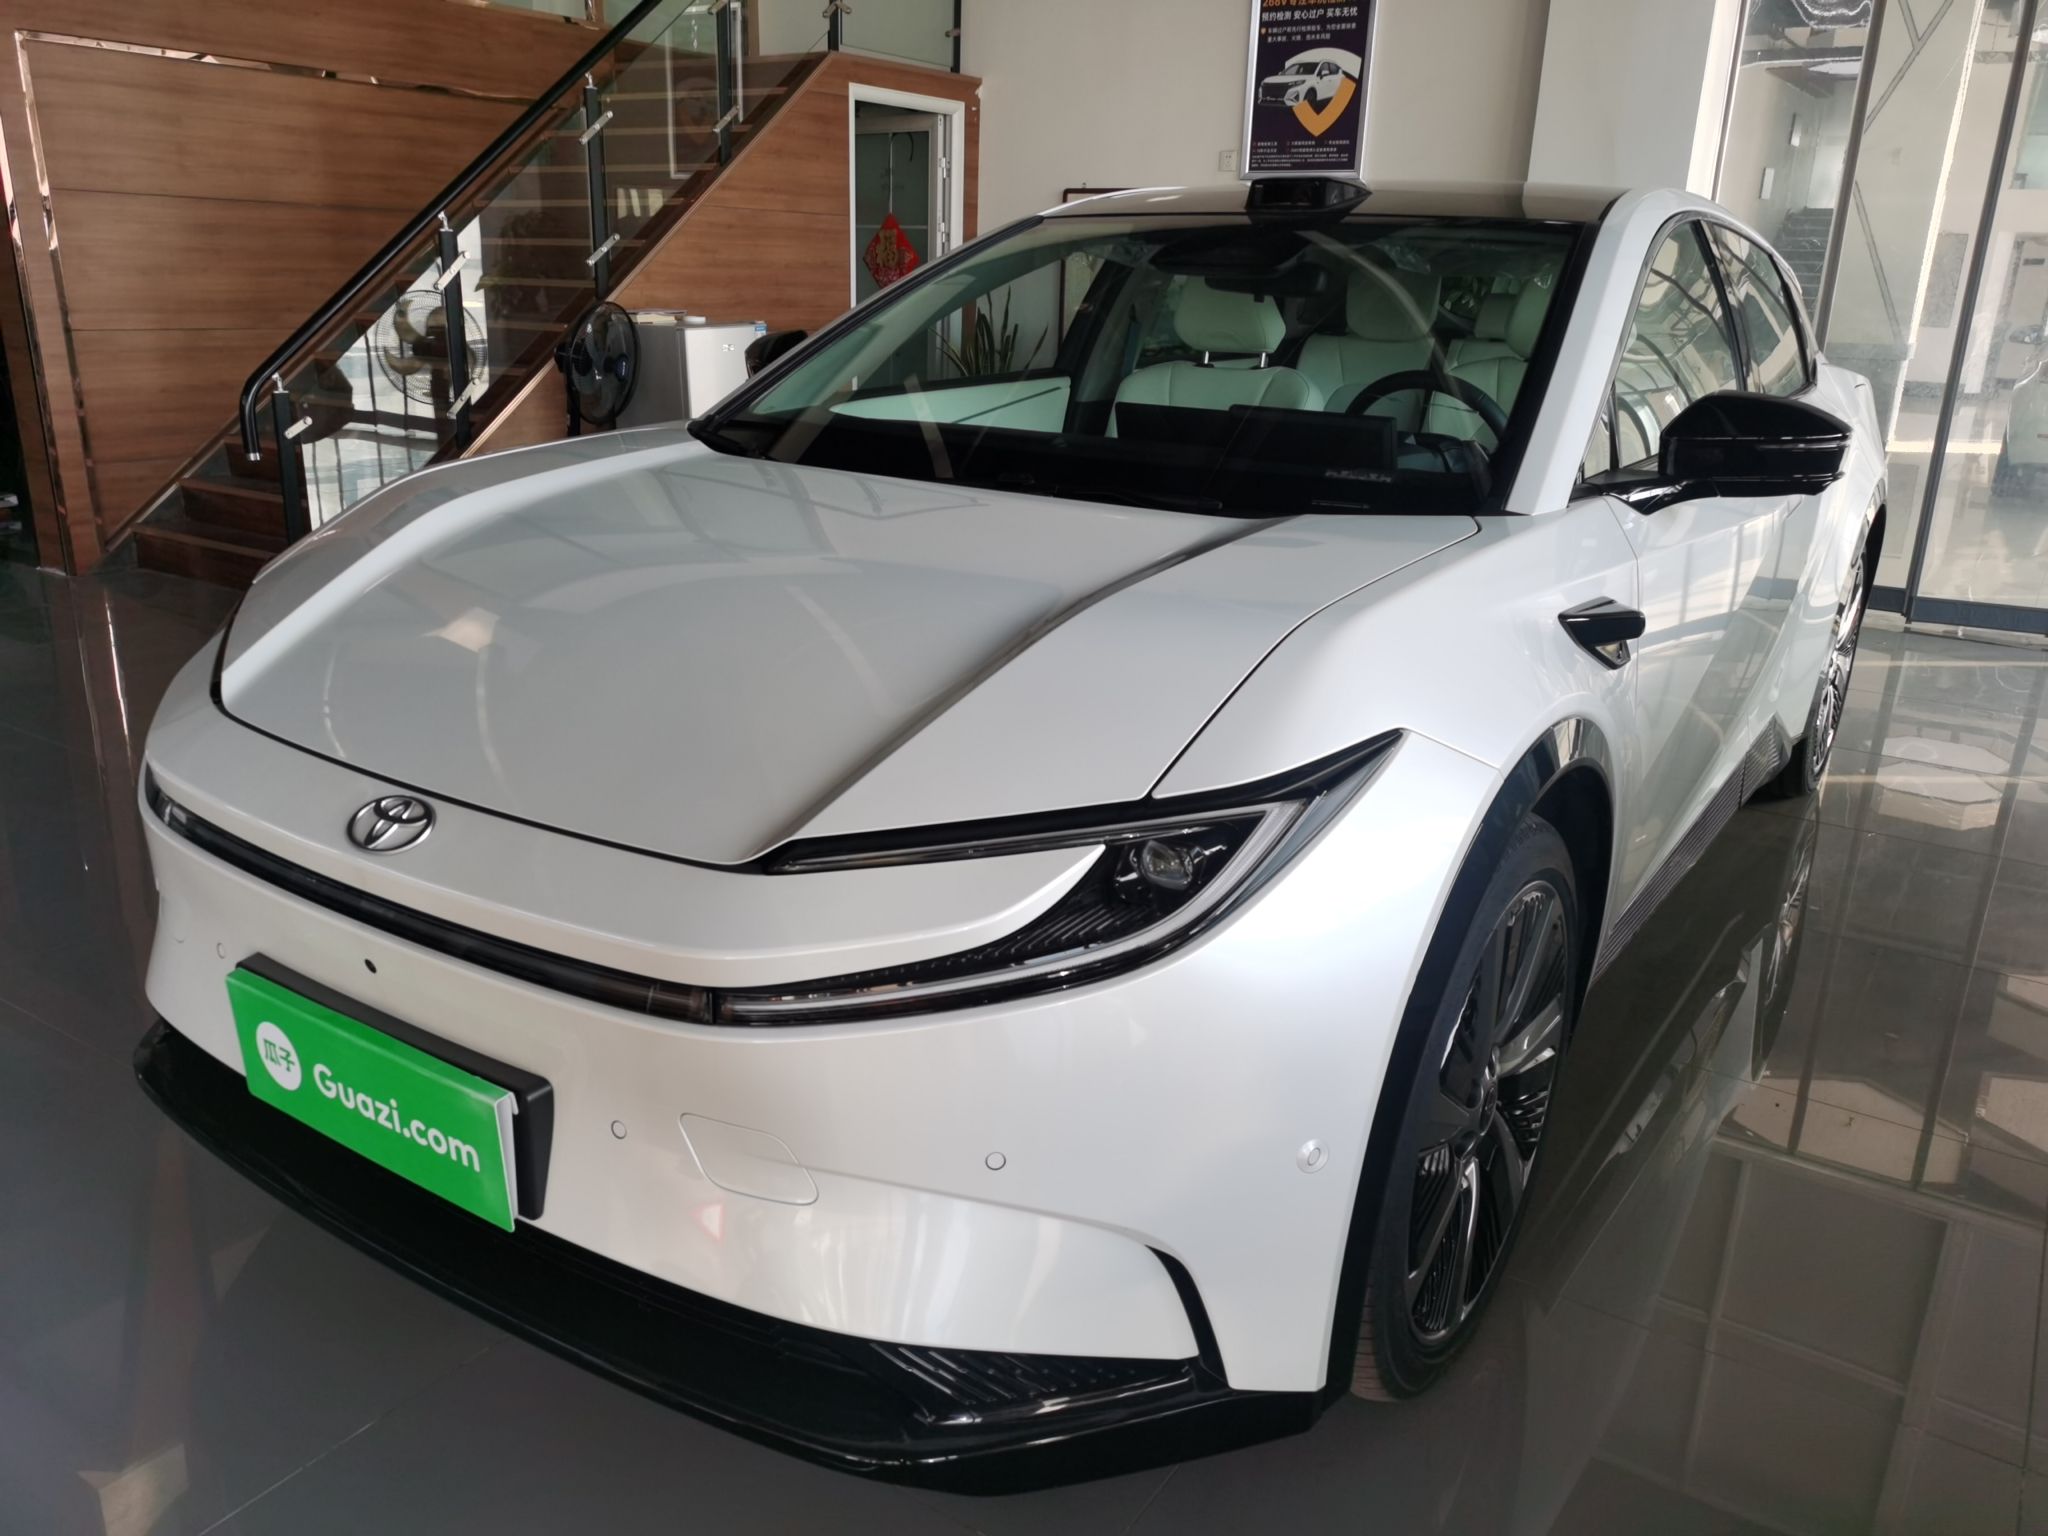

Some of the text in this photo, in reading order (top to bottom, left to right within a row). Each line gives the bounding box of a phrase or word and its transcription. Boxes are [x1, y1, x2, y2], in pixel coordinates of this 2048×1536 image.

[1293, 9, 1324, 20] 安心过户
[1326, 7, 1358, 18] 买车无忧
[263, 1039, 295, 1072] 瓜子
[313, 1063, 480, 1173] Guazi.com
